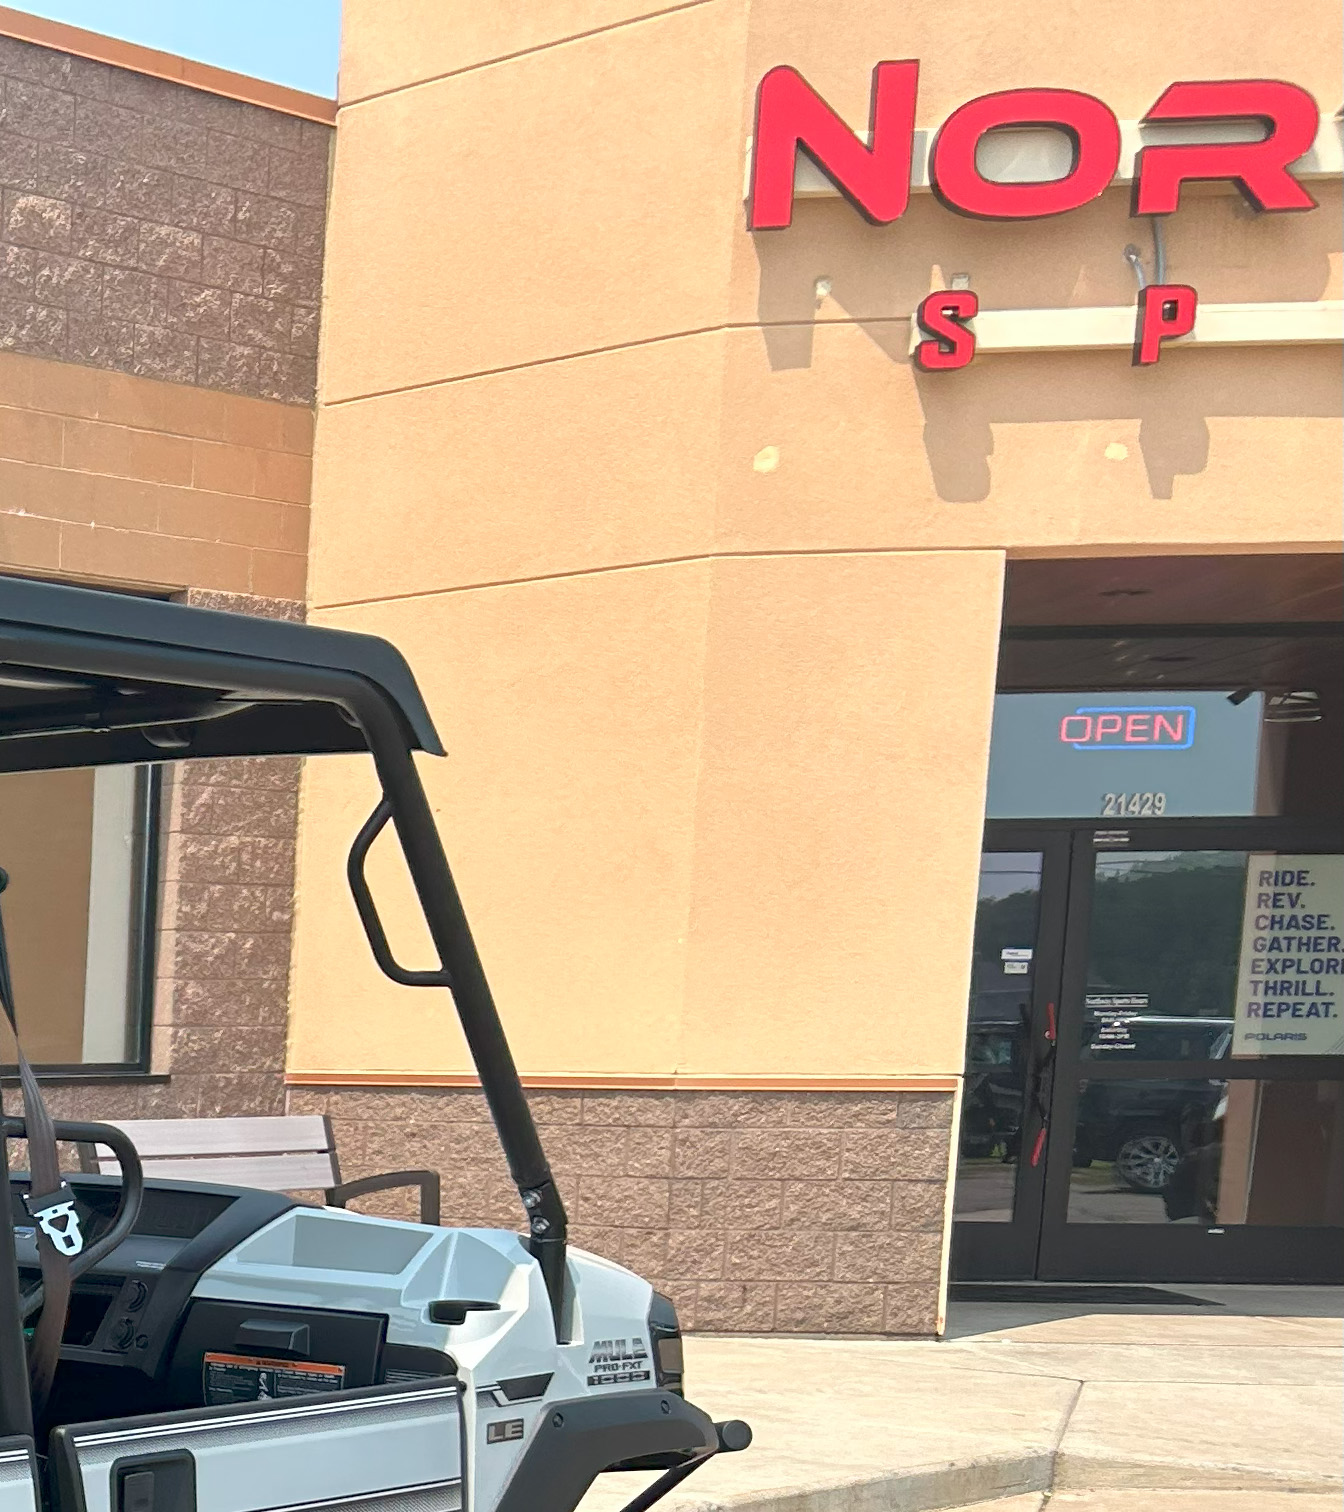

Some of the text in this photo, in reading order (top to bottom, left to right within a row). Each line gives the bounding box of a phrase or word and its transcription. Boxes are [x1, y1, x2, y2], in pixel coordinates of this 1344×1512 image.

[747, 58, 1344, 231] NOR
[1060, 714, 1183, 742] OPEN
[1101, 792, 1166, 817] 21429
[1259, 870, 1315, 887] RIDE.
[1257, 892, 1306, 909] REV.
[1254, 914, 1336, 931] CHASE.
[1250, 958, 1344, 975] EXPLOR
[1249, 980, 1335, 997] THRILL.
[1246, 1002, 1338, 1018] REPEAT.
[1244, 1033, 1308, 1041] POLARIS
[588, 1337, 648, 1363] MULE
[487, 1418, 524, 1444] LE
